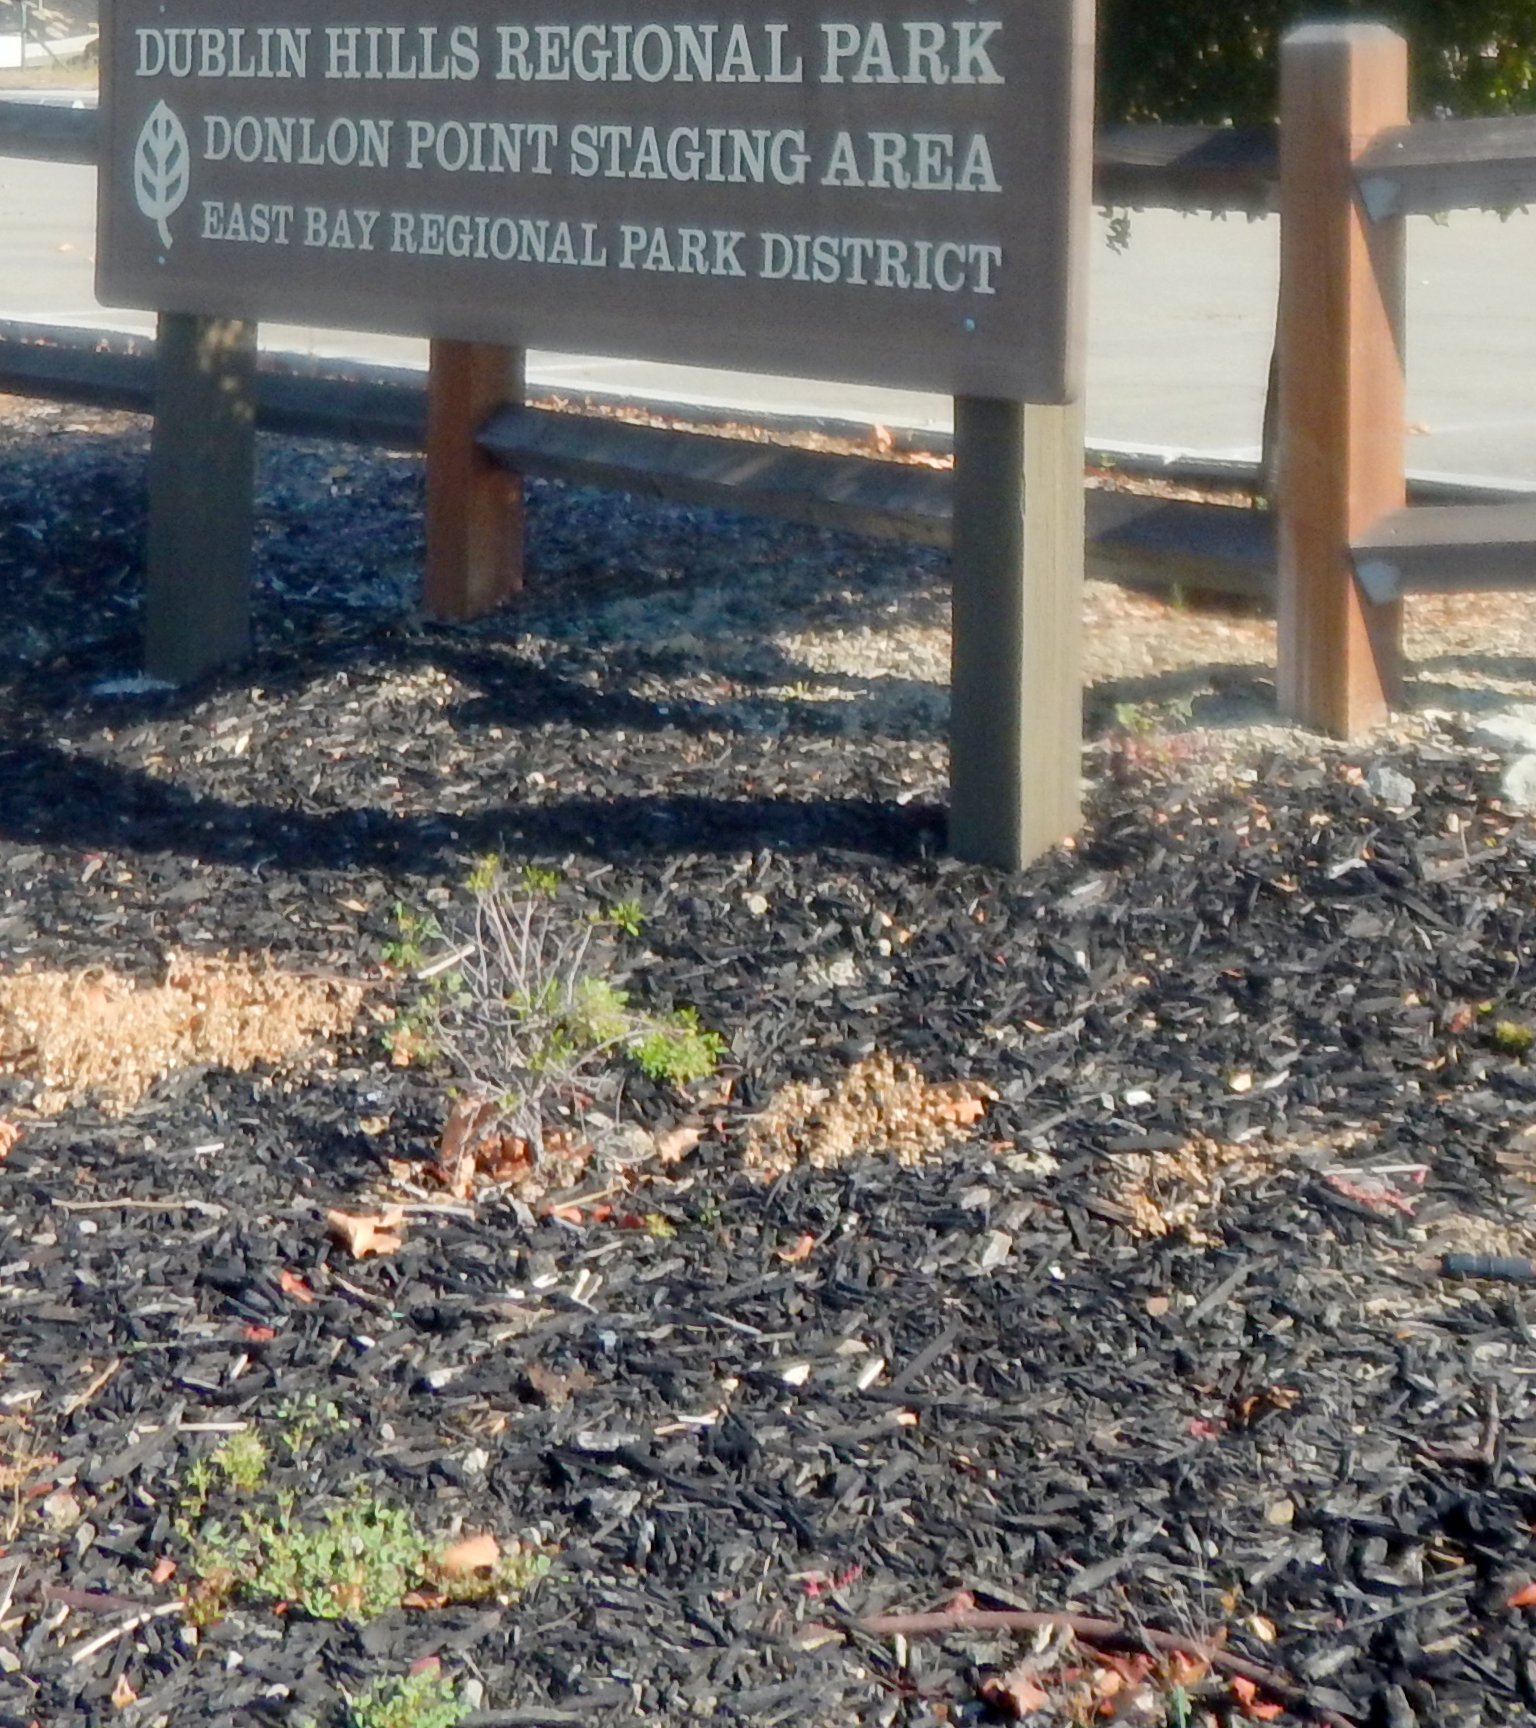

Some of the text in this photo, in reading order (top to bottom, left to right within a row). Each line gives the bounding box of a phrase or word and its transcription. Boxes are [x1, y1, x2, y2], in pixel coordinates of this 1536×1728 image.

[135, 20, 1005, 85] DUBLIN HILLS REGIONAL PARK
[203, 115, 1003, 193] DONLON POINT STAGING AREA
[200, 200, 1002, 295] EAST BAY REGIONAL PARK DISTRICT
